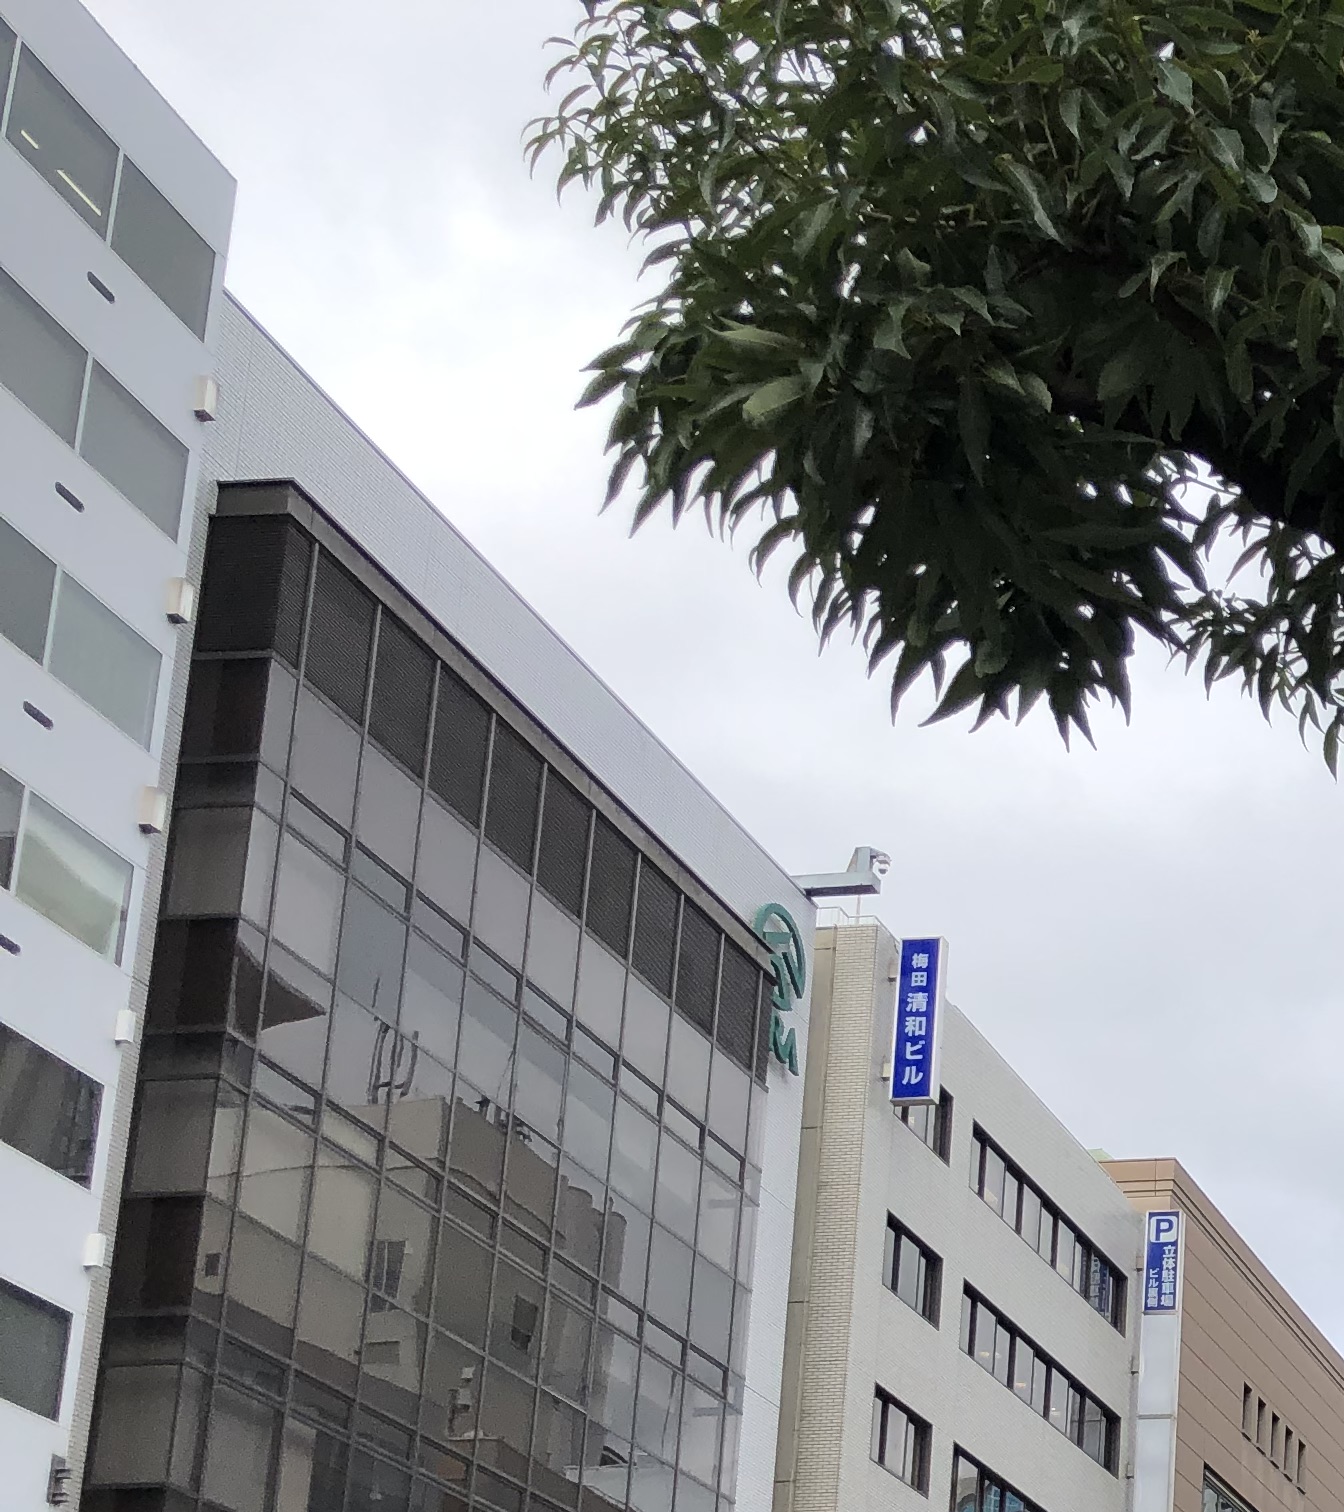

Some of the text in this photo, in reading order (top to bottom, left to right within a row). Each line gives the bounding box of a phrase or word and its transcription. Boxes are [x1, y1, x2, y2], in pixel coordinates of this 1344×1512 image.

[901, 953, 930, 1085] 梅田清和ビル
[1154, 1218, 1174, 1242] P
